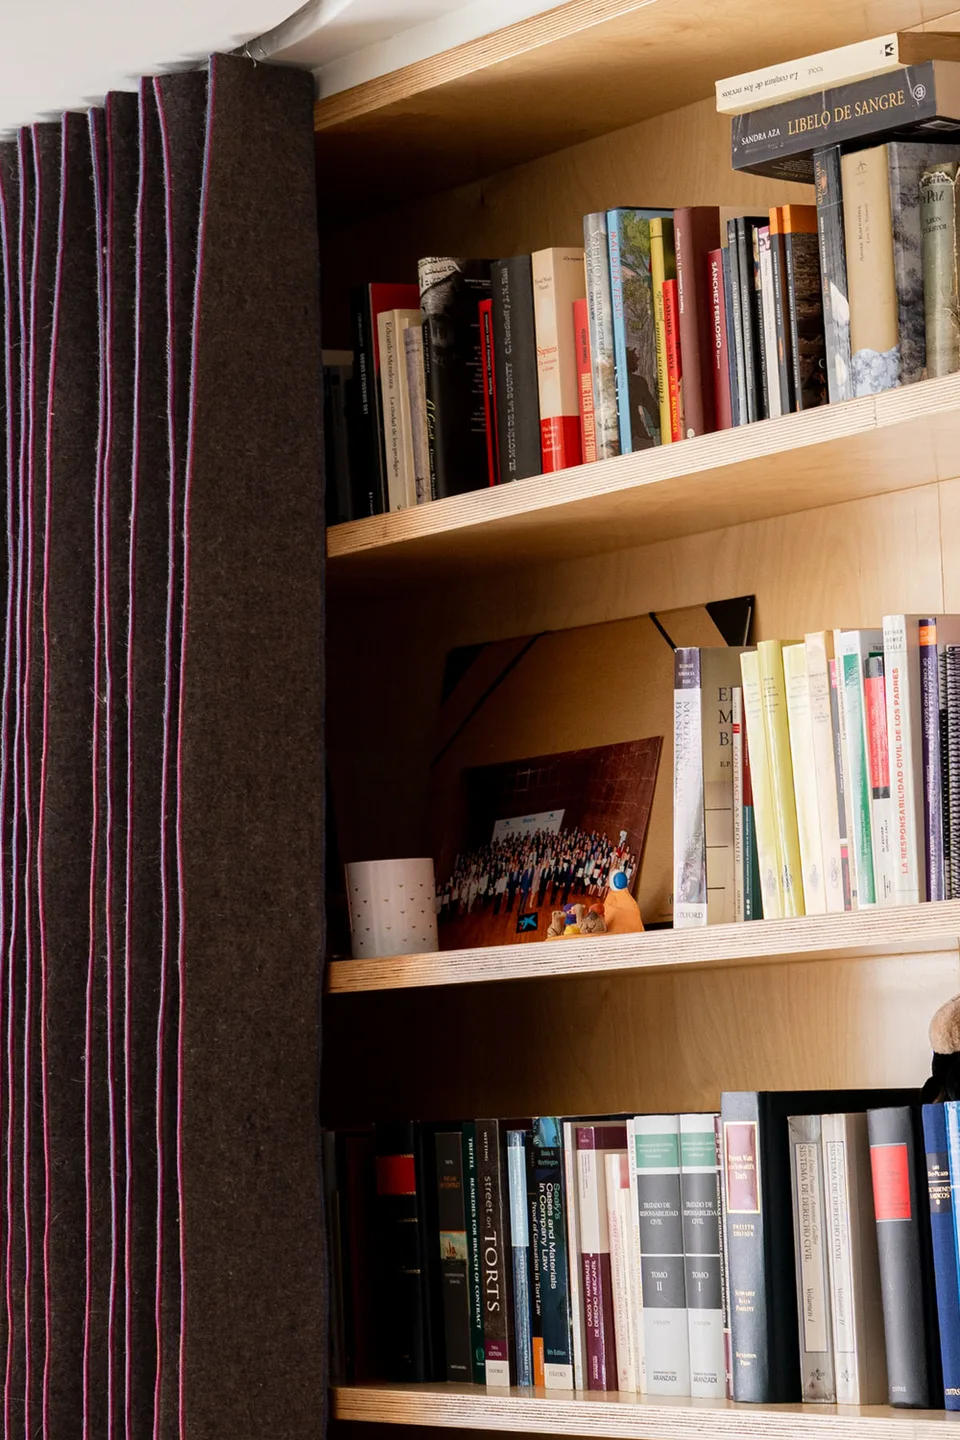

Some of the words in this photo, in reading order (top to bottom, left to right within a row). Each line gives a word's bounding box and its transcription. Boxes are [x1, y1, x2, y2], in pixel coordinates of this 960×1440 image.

[744, 83, 754, 92] los
[756, 80, 764, 90] de
[787, 110, 830, 136] LIBELO
[834, 106, 851, 124] DE
[854, 90, 906, 118] SANGRE
[741, 131, 768, 146] SANDRA
[768, 128, 780, 140] AZA
[710, 261, 720, 304] SÁNCHEZ
[612, 288, 623, 320] TESIS
[665, 298, 673, 336] CATCHER
[385, 322, 394, 354] Eduardo
[714, 305, 722, 349] FERLOSIO
[388, 354, 396, 389] Mendoza
[505, 362, 514, 399] BOUNTY
[580, 372, 594, 412] NINETEEN
[584, 413, 597, 462] EIGHTY-FOUR
[391, 448, 399, 478] prodigios
[892, 668, 900, 706] PADRES
[895, 730, 902, 742] DE
[897, 770, 908, 860] RESPONSABILIDAD
[902, 862, 908, 874] LA
[799, 1145, 808, 1183] SISTEMA
[828, 1144, 838, 1181] SISTEMA
[484, 1175, 494, 1214] street
[538, 1182, 547, 1192] in
[545, 1182, 555, 1216] Cases
[553, 1183, 562, 1220] Sealy's
[800, 1184, 808, 1196] DE
[830, 1182, 838, 1194] DE
[486, 1216, 492, 1228] on
[539, 1195, 549, 1248] Company
[548, 1219, 556, 1239] and
[802, 1196, 810, 1238] DERECHO
[832, 1196, 840, 1237] DERECHO
[484, 1230, 500, 1312] TORTS
[542, 1249, 550, 1272] Law
[548, 1242, 558, 1290] Materials
[474, 1272, 480, 1282] OF
[656, 1282, 662, 1292] II
[698, 1282, 702, 1292] I
[592, 1296, 600, 1326] DERECHO
[806, 1288, 814, 1316] Volumen
[836, 1288, 844, 1318] Volumen
[594, 1328, 600, 1338] DE
[838, 1318, 846, 1326] II
